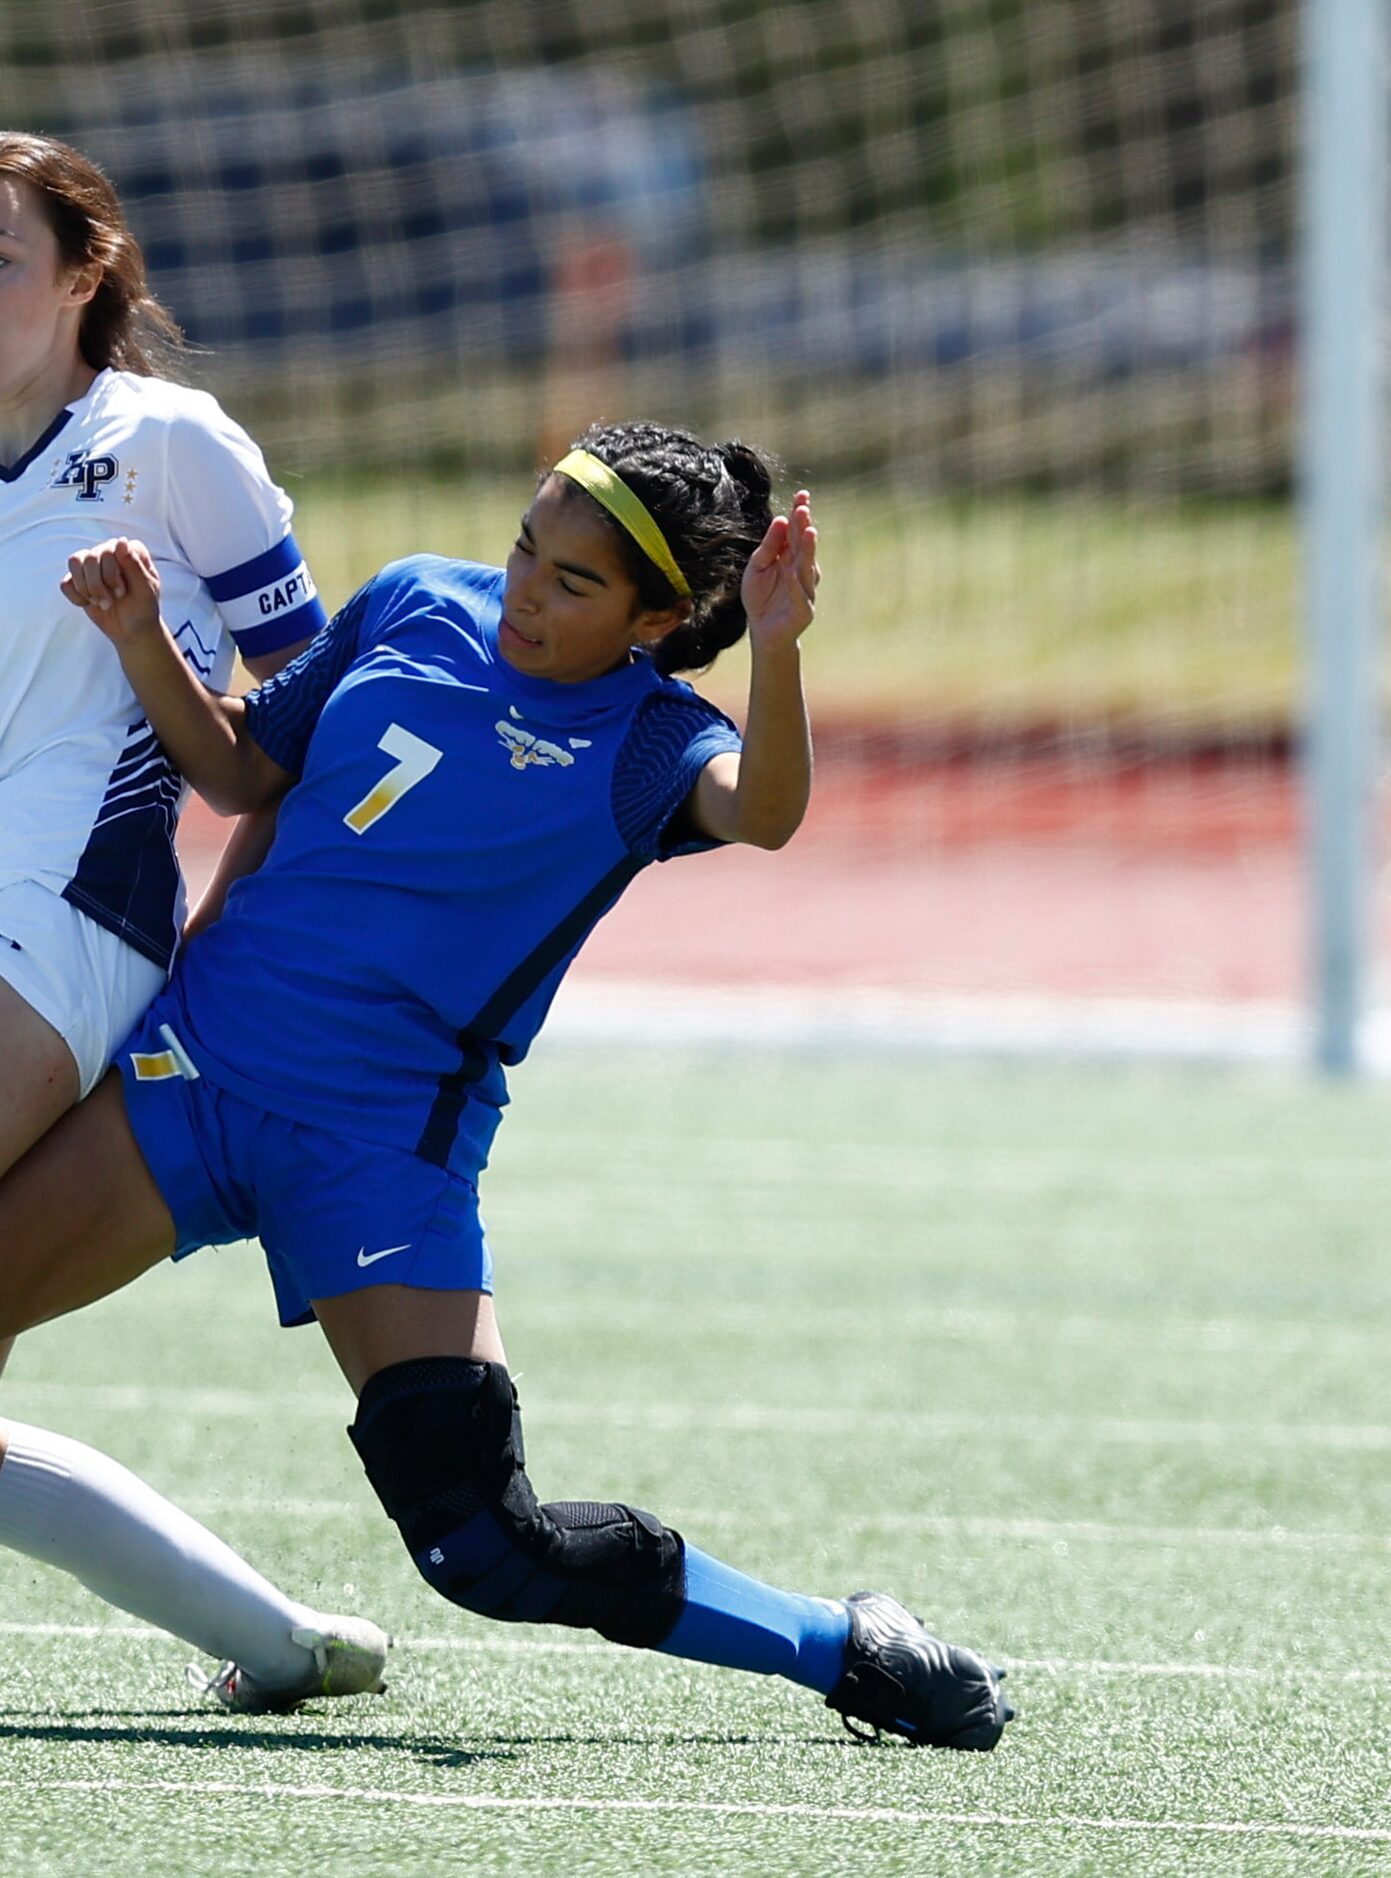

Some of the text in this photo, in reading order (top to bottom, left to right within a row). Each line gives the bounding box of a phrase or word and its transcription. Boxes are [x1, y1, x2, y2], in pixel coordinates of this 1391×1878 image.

[50, 449, 119, 502] AP
[258, 572, 312, 615] CAPT
[343, 722, 444, 836] 7
